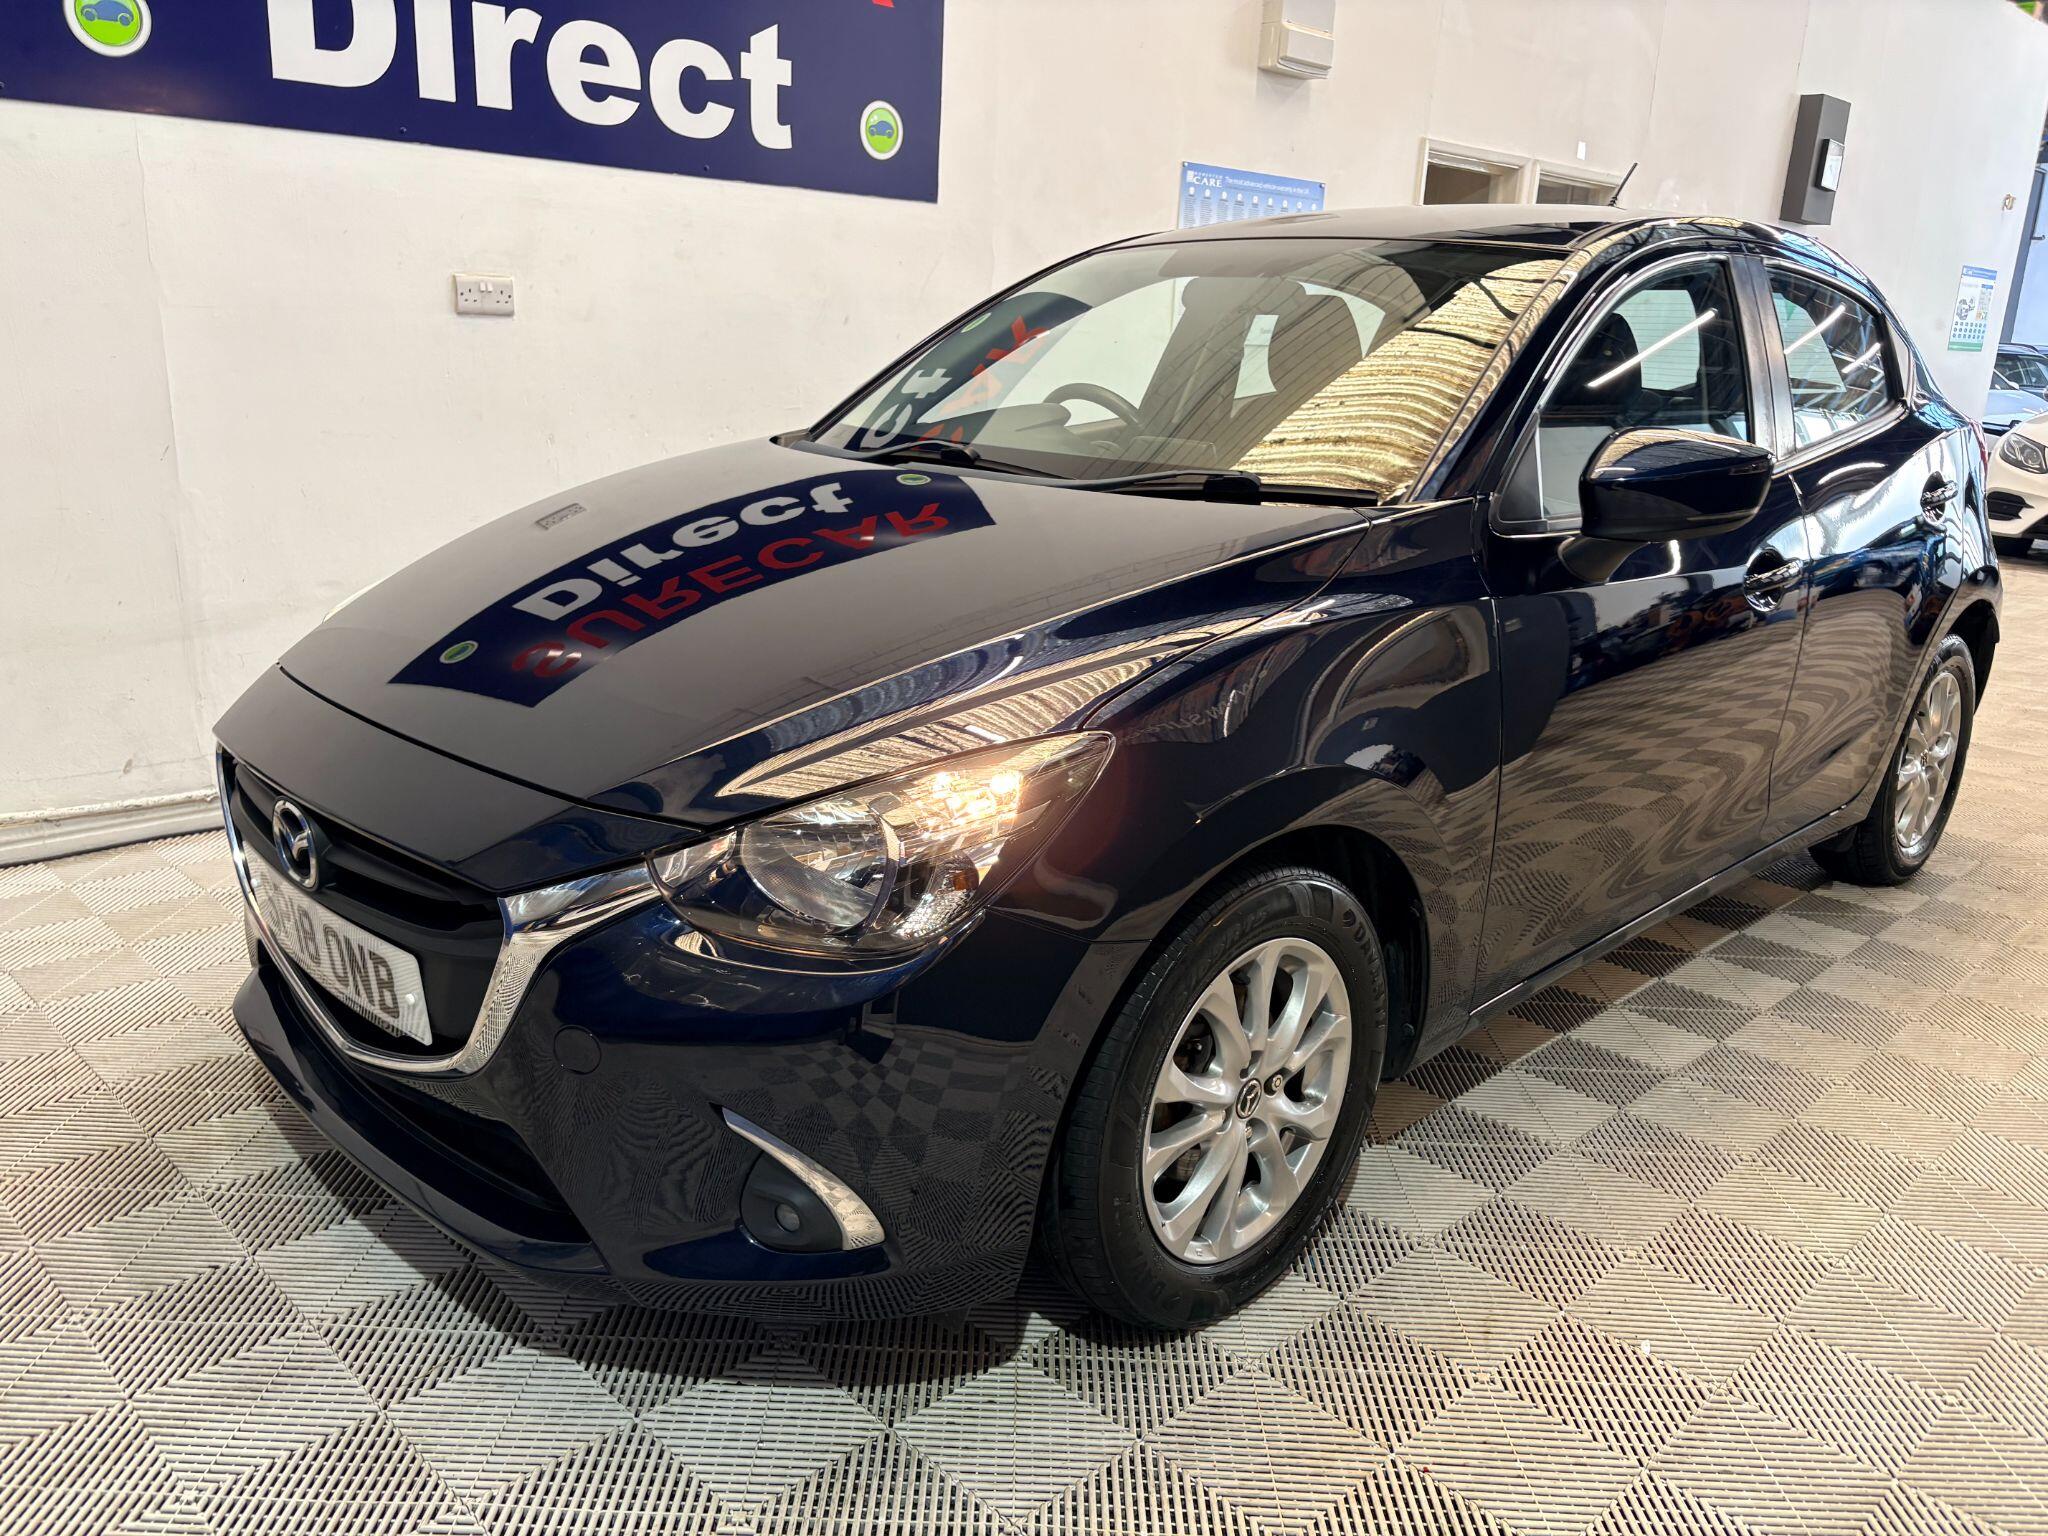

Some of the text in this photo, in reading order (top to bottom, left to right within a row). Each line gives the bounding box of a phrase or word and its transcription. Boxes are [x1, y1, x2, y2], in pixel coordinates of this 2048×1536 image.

[268, 0, 793, 150] Direct
[1193, 176, 1223, 188] CARE
[320, 919, 402, 1027] ONB
